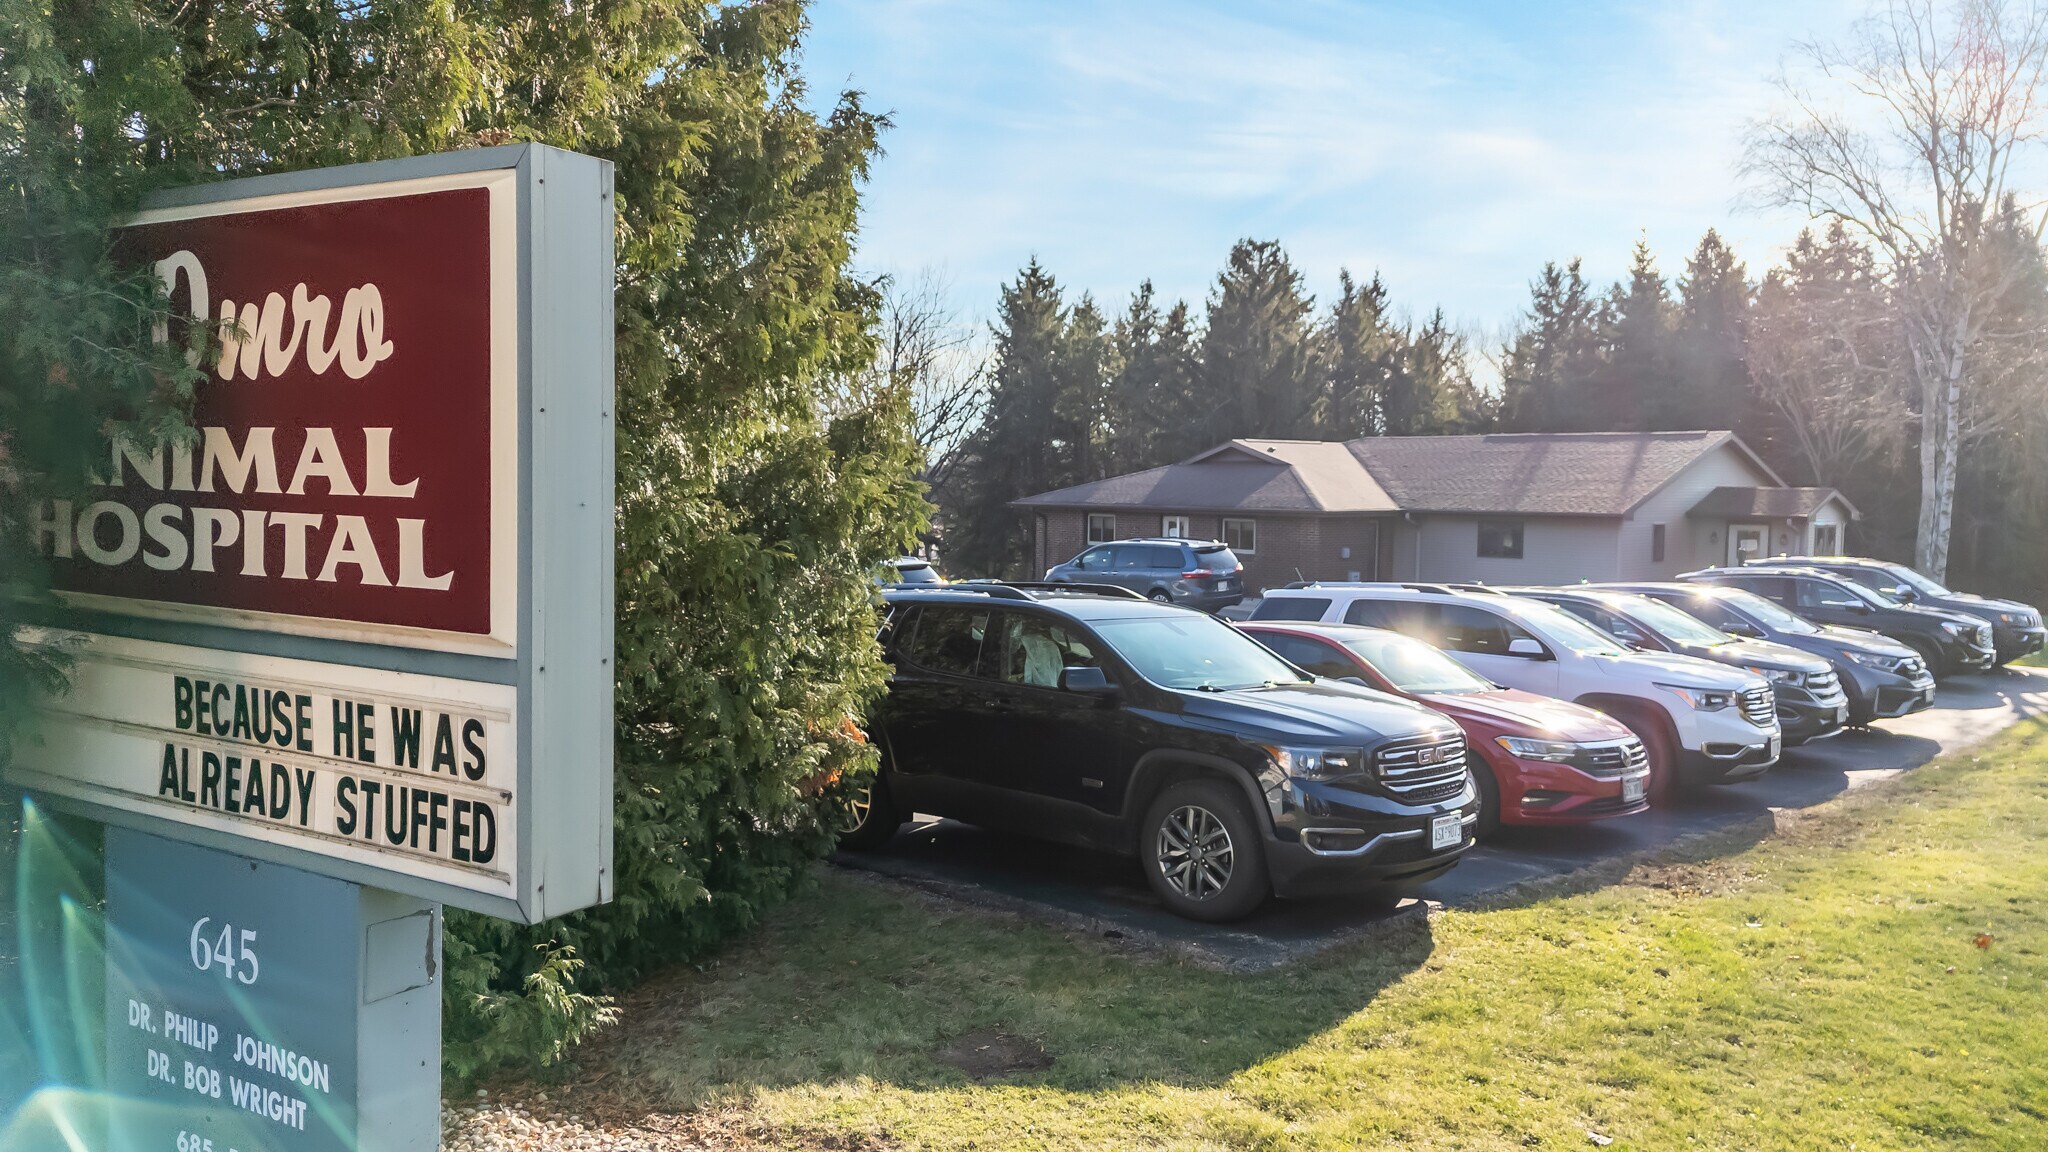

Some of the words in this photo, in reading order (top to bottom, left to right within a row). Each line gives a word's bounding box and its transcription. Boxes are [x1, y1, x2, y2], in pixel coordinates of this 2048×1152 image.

[87, 426, 419, 498] NIMAL
[28, 499, 454, 590] HOSPITAL
[174, 676, 313, 752] BECAUSE
[333, 698, 375, 763] HE
[391, 706, 486, 781] WAS
[159, 743, 315, 826] ALREADY
[336, 776, 496, 864] STUFFED
[190, 916, 259, 984] 645
[129, 999, 157, 1034] DR.
[164, 1010, 218, 1051] PHILIP
[233, 1034, 330, 1093] JOHNSON
[148, 1048, 176, 1085] DR.
[184, 1061, 221, 1098] BOB
[230, 1075, 306, 1131] WRIGHT
